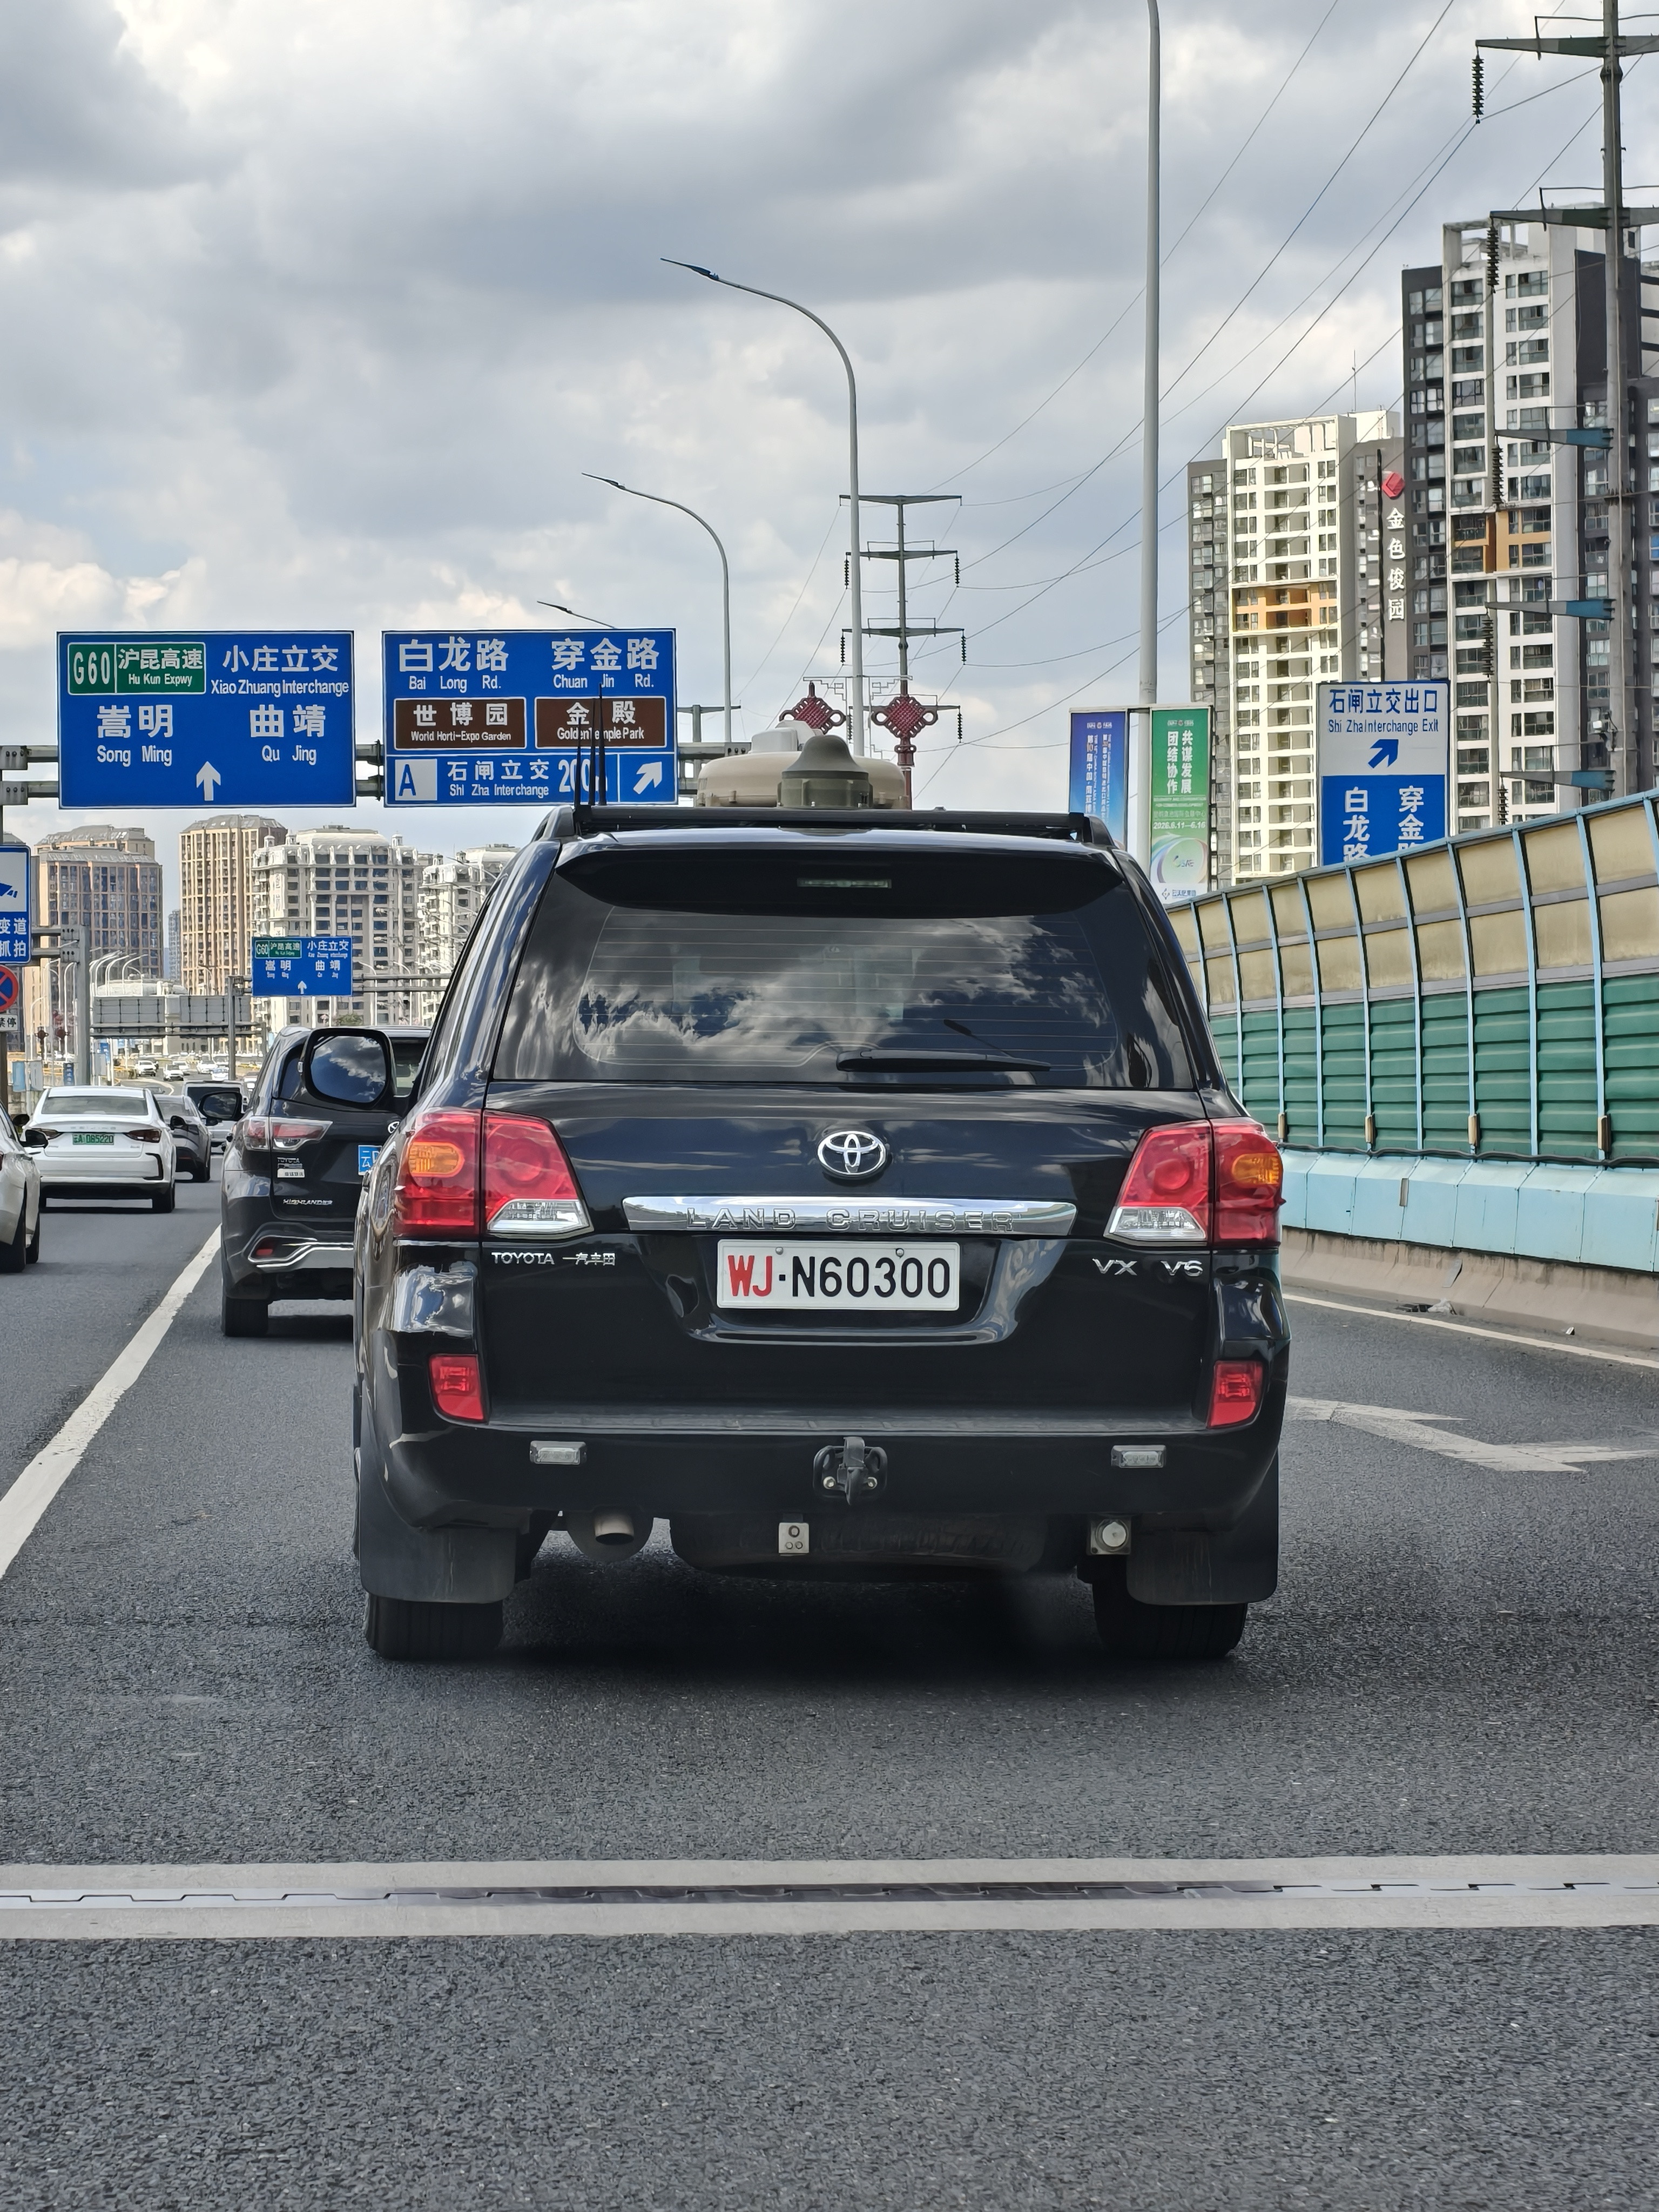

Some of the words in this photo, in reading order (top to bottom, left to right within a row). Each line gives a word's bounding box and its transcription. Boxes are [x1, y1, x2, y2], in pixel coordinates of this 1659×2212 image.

[1386, 507, 1405, 621] 金色俊园
[118, 648, 203, 671] 沪昆高速
[222, 645, 339, 673] 小庄立交
[399, 636, 509, 672] 白龙路
[551, 637, 659, 671] 穿金路
[73, 651, 110, 685] G60
[129, 673, 140, 685] Hu
[144, 673, 160, 685] Kun
[164, 673, 192, 686] Expwy
[211, 679, 237, 694] Xiao
[238, 679, 280, 698] Zhuang
[282, 679, 349, 697] Interchange
[409, 676, 426, 690] Bai
[440, 676, 467, 693] Long
[482, 676, 502, 689] Rd.
[554, 675, 588, 689] Chuan
[601, 674, 614, 688] Jin
[635, 674, 655, 688] Rd.
[1329, 688, 1437, 714] 石闸立交出口
[97, 704, 173, 738] 嵩明
[250, 704, 326, 738] 曲靖
[413, 703, 508, 726] 世博园
[567, 701, 636, 725] 金殿
[411, 731, 434, 741] World
[437, 731, 480, 743] Horti-Expo
[482, 732, 511, 741] Garden
[623, 726, 644, 740] Park
[1328, 719, 1342, 733] Shi
[1346, 719, 1363, 733] Zha
[1364, 719, 1418, 736] Interchange
[1422, 718, 1439, 732] Exit
[97, 745, 131, 767] Song
[142, 745, 172, 766] Ming
[262, 745, 280, 763] Qu
[292, 745, 316, 766] Jing
[1167, 731, 1179, 794] 团结协作
[1181, 730, 1193, 794] 共谋发展
[399, 764, 416, 796] A
[447, 759, 550, 781] 石闸立交
[449, 784, 464, 796] Shi
[471, 784, 489, 796] Zha
[1343, 786, 1371, 862] 白龙路
[1398, 785, 1424, 852] 穿金
[0, 918, 27, 935] 变道
[257, 943, 268, 955] G60
[307, 939, 349, 951] 小庄立交
[686, 1208, 797, 1231] LAND
[826, 1209, 1015, 1232] CRUISER
[491, 1252, 555, 1265] TOYOTA
[562, 1252, 615, 1266] 一汽丰田
[1092, 1258, 1137, 1276] VX
[1161, 1260, 1203, 1277] V6
